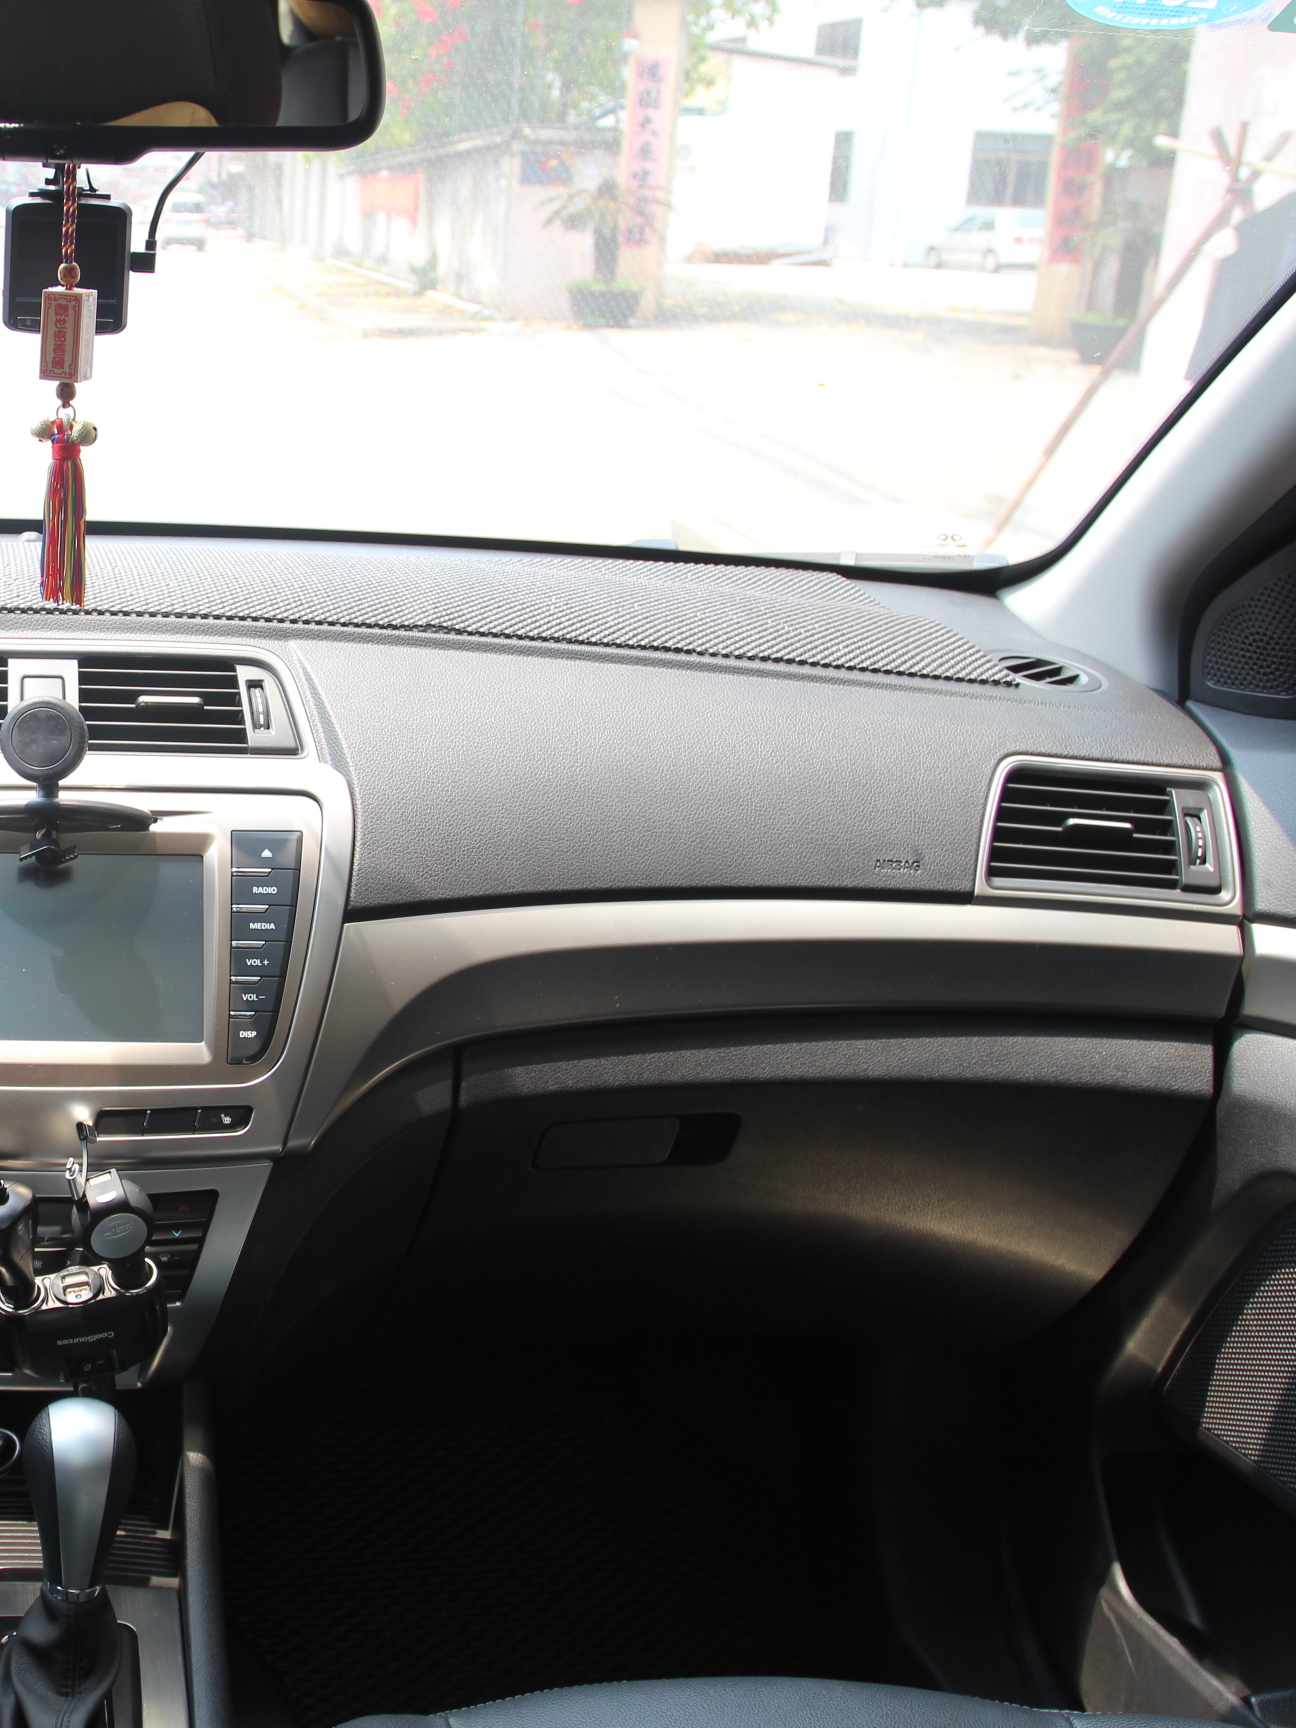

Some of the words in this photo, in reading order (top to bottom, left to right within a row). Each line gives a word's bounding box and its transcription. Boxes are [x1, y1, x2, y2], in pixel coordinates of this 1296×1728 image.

[874, 859, 922, 872] AIRBAG
[252, 885, 278, 895] RADIO
[249, 921, 276, 931] MEDIA
[239, 1029, 257, 1039] DISP
[56, 1331, 115, 1346] CoolSources
